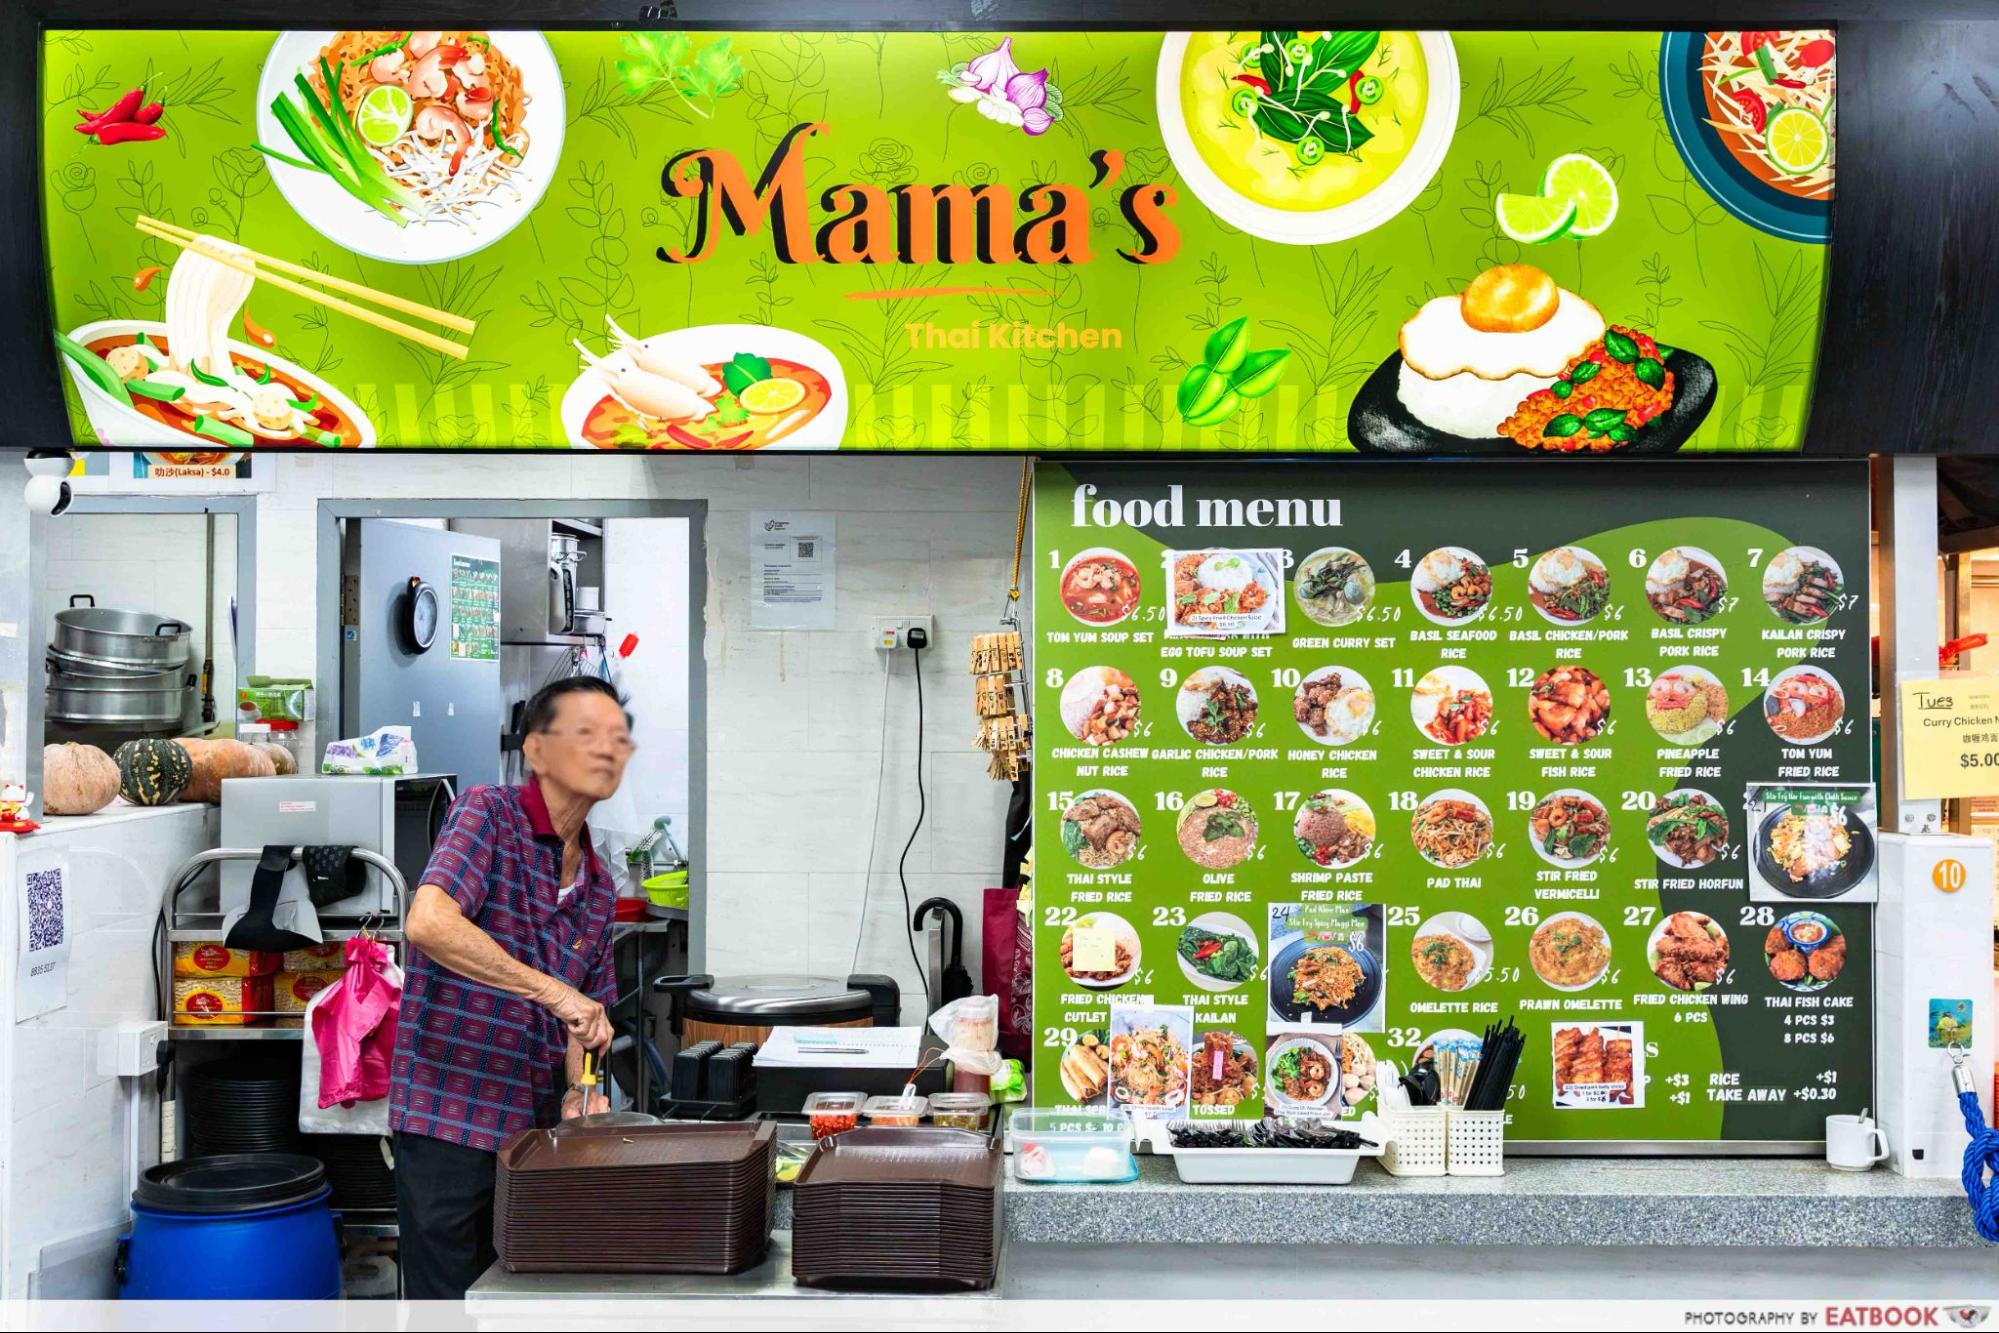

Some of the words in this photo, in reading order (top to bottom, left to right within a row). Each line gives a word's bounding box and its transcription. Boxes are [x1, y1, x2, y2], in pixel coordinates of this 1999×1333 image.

[656, 122, 1182, 264] Mama's
[904, 322, 981, 349] Thai
[989, 321, 1122, 349] Kitchen
[1072, 484, 1185, 527] food
[1197, 499, 1343, 527] menu
[1049, 550, 1061, 569] 1
[1395, 549, 1412, 568] 4
[1513, 548, 1529, 568] 5
[1629, 549, 1647, 568] 6
[1747, 549, 1764, 568] 7
[1718, 597, 1739, 614] $7
[1838, 594, 1858, 611] $7
[1121, 607, 1166, 622] $6.50
[1355, 606, 1401, 622] $6.50
[1478, 606, 1523, 622] $6.50
[1604, 605, 1623, 621] $6
[1047, 632, 1070, 644] TOM
[1073, 632, 1098, 644] YUM
[1100, 632, 1129, 644] SOUP
[1133, 632, 1154, 644] SET
[1410, 630, 1442, 641] BASIL
[1446, 630, 1497, 641] SEAFOOD
[1510, 629, 1542, 641] BASIL
[1545, 629, 1629, 641] CHICKEN/PORK
[1651, 628, 1683, 640] BASIL
[1687, 628, 1727, 640] CRISPY
[1762, 628, 1804, 641] KAILAN
[1807, 628, 1846, 641] CRISPY
[1292, 637, 1329, 649] GREEN
[1333, 637, 1370, 649] CURRY
[1374, 637, 1396, 649] SET
[1161, 647, 1182, 657] EGG
[1186, 647, 1215, 657] TOFU
[1219, 647, 1247, 657] SOUP
[1251, 647, 1272, 657] SET
[1441, 648, 1466, 659] RICE
[1556, 648, 1582, 659] RICE
[1659, 645, 1690, 657] PORK
[1693, 645, 1719, 657] RICE
[1777, 647, 1807, 658] PORK
[1810, 647, 1835, 658] RICE
[1046, 668, 1063, 687] 8
[1160, 668, 1177, 687] 9
[1272, 668, 1300, 687] 10
[1392, 668, 1414, 687] 11
[1506, 668, 1535, 687] 12
[1624, 668, 1652, 687] 13
[1741, 668, 1770, 687] 14
[1912, 692, 1953, 709] Tues
[1923, 718, 1951, 728] Curry
[1954, 716, 1993, 726] Chicken
[1052, 747, 1099, 759] CHICKEN
[1103, 747, 1149, 759] CASHEW
[1152, 748, 1191, 760] GARLIC
[1195, 748, 1278, 760] CHICKEN/PORK
[1288, 749, 1325, 760] HONEY
[1329, 749, 1377, 760] CHICKEN
[1412, 749, 1450, 760] SWEET
[1454, 749, 1462, 760] &
[1466, 749, 1495, 760] SOUR
[1529, 748, 1567, 759] SWEET
[1571, 748, 1579, 759] &
[1582, 748, 1612, 759] SOUR
[1657, 748, 1719, 759] PINEAPPLE
[1781, 748, 1804, 759] TOM
[1808, 748, 1833, 759] YUM
[1076, 766, 1099, 777] NUT
[1103, 766, 1128, 777] RICE
[1202, 767, 1227, 777] RICE
[1321, 768, 1347, 779] RICE
[1413, 767, 1461, 777] CHICKEN
[1465, 767, 1491, 777] RICE
[1541, 766, 1567, 777] FISH
[1570, 766, 1596, 777] RICE
[1659, 766, 1693, 778] FRIED
[1696, 766, 1721, 778] RICE
[1778, 766, 1810, 777] FRIED
[1814, 766, 1839, 777] RICE
[1047, 791, 1074, 810] 15
[1155, 791, 1184, 810] 16
[1274, 791, 1300, 810] 17
[1388, 791, 1418, 810] 18
[1507, 791, 1535, 810] 19
[1621, 791, 1656, 810] 20
[1067, 873, 1094, 885] THAI
[1097, 873, 1132, 885] STYLE
[1203, 874, 1234, 885] OLIVE
[1291, 872, 1332, 884] SHRIMP
[1335, 872, 1373, 884] PASTE
[1536, 870, 1563, 882] STIR
[1566, 870, 1598, 882] FRIED
[1939, 862, 1961, 888] 10
[1427, 878, 1450, 889] PAD
[1455, 878, 1482, 889] THAI
[1634, 878, 1659, 890] STIR
[1663, 878, 1695, 890] FRIED
[1698, 878, 1744, 890] HORFUN
[1071, 892, 1103, 902] FRIED
[1107, 892, 1132, 902] RICE
[1190, 891, 1222, 902] FRIED
[1226, 891, 1251, 902] RICE
[1301, 890, 1333, 901] FRIED
[1337, 890, 1362, 901] RICE
[1534, 889, 1600, 900] VERMICELLI
[1045, 907, 1076, 926] 22
[1152, 907, 1186, 926] 23
[1272, 905, 1290, 922] 24
[1388, 907, 1420, 926] 25
[1504, 907, 1539, 926] 26
[1623, 907, 1656, 926] 27
[1739, 907, 1775, 926] 28
[1061, 994, 1093, 1005] FRIED
[1096, 994, 1145, 1005] CHICKEN
[1183, 995, 1210, 1006] THAI
[1213, 995, 1248, 1006] STYLE
[1519, 999, 1559, 1010] PRAWN
[1563, 999, 1622, 1010] OMELETTE
[1633, 994, 1666, 1005] FRIED
[1669, 994, 1718, 1005] CHICKEN
[1721, 994, 1749, 1005] WING
[1765, 997, 1792, 1008] THAI
[1796, 997, 1819, 1008] FISH
[1823, 997, 1854, 1008] CAKE
[1410, 1002, 1468, 1013] OMELETTE
[1473, 1002, 1498, 1013] RICE
[1064, 1012, 1106, 1023] CUTLET
[1194, 1012, 1236, 1024] KAILAN
[1674, 1012, 1682, 1023] 6
[1685, 1012, 1708, 1023] PCS
[1784, 1014, 1792, 1026] 4
[1795, 1014, 1817, 1026] PCS
[1821, 1014, 1835, 1026] $3
[1044, 1027, 1077, 1047] 29
[1387, 1027, 1421, 1047] 32
[1784, 1033, 1792, 1045] 8
[1795, 1033, 1817, 1045] PCS
[1821, 1033, 1835, 1045] $6
[1665, 1073, 1690, 1087] +$3
[1709, 1072, 1739, 1085] RICE
[1815, 1071, 1837, 1084] +$1
[1670, 1091, 1690, 1106] +$1
[1707, 1089, 1742, 1101] TAKE
[1747, 1089, 1786, 1101] AWAY
[1793, 1087, 1837, 1101] +$0.30
[1193, 1105, 1235, 1115] TOSSED
